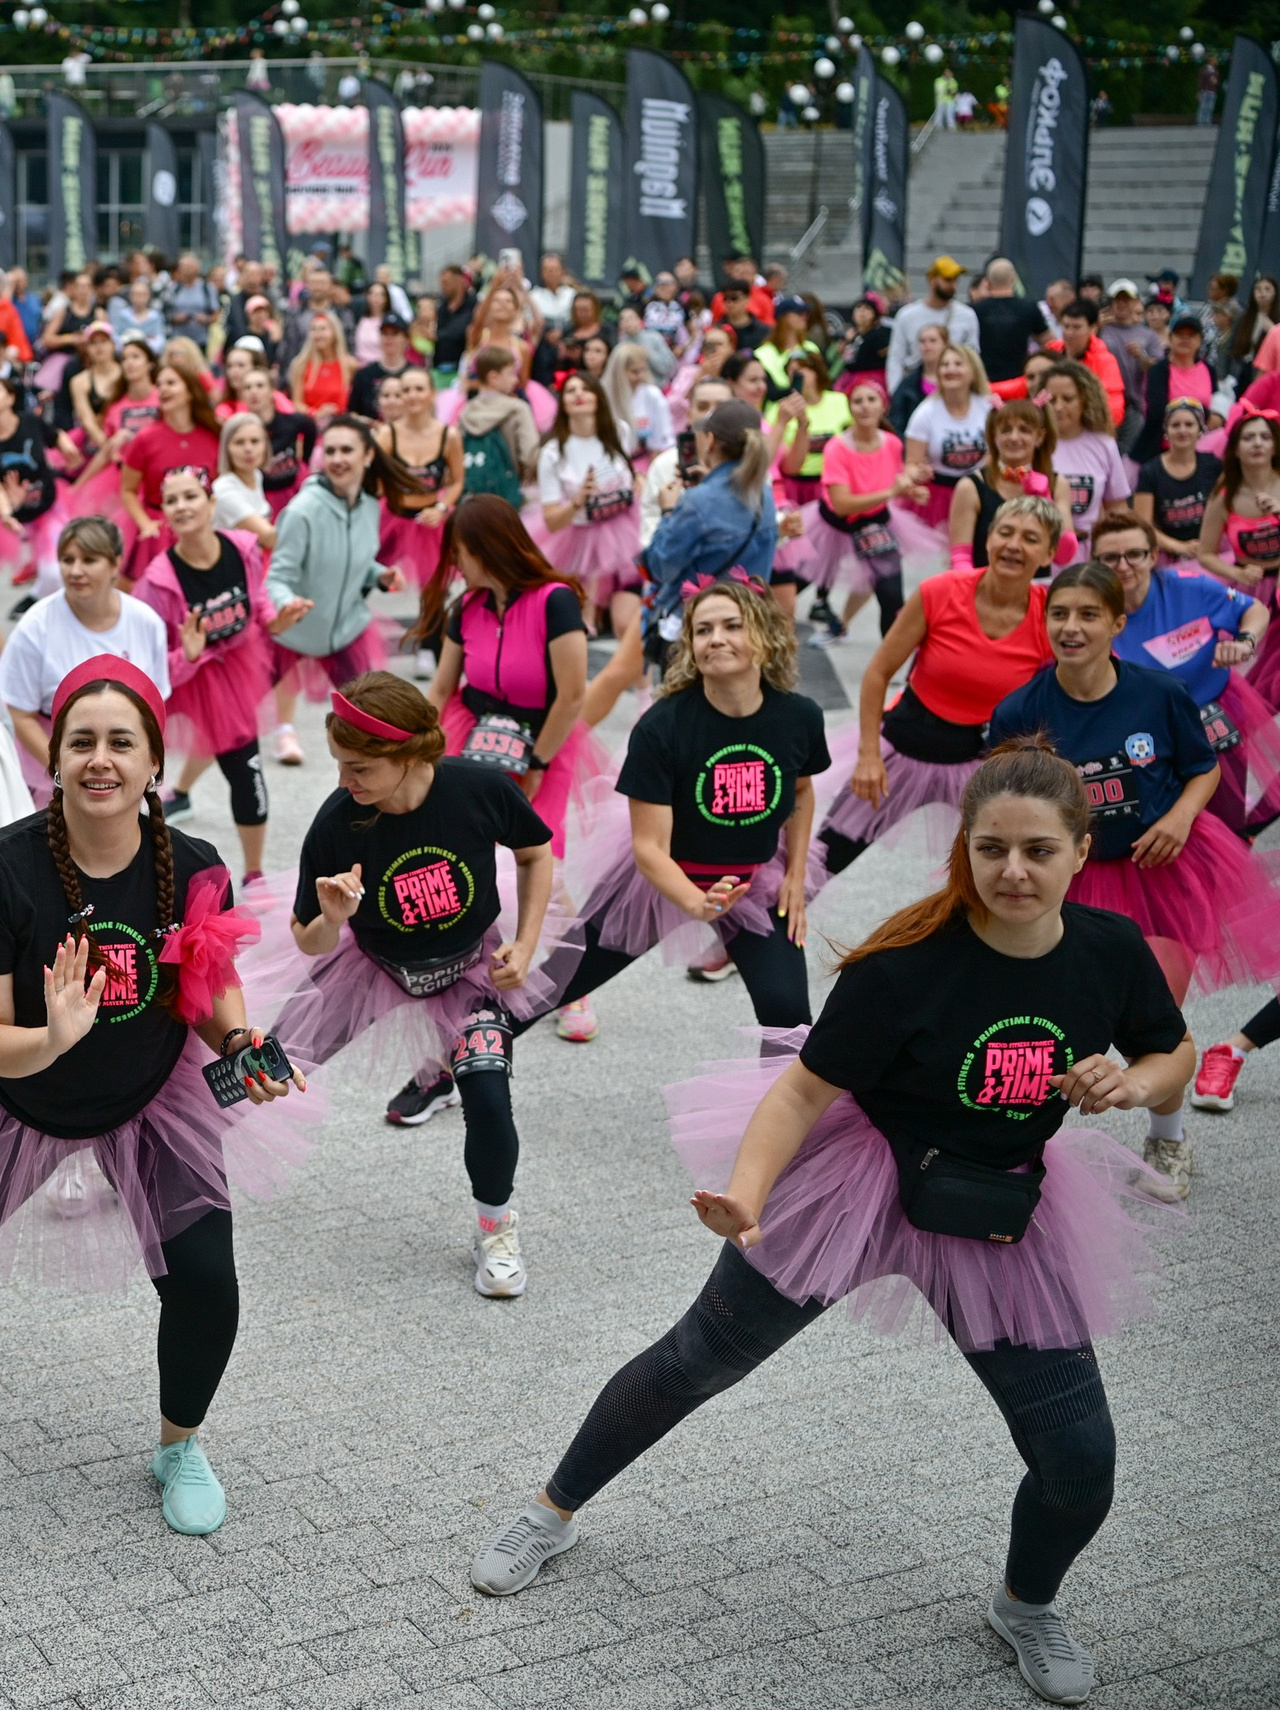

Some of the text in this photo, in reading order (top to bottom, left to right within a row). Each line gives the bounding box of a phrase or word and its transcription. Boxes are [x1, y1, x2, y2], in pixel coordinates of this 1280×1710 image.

[470, 731, 527, 761] 5335
[727, 785, 767, 808] TIME
[415, 886, 461, 918] TIME
[452, 1029, 505, 1062] 242
[973, 1016, 1066, 1049] PRIMETIME FITNESS
[1031, 1039, 1055, 1047] PROJECT
[957, 1051, 975, 1091] FITNESS
[999, 1073, 1053, 1101] TIME
